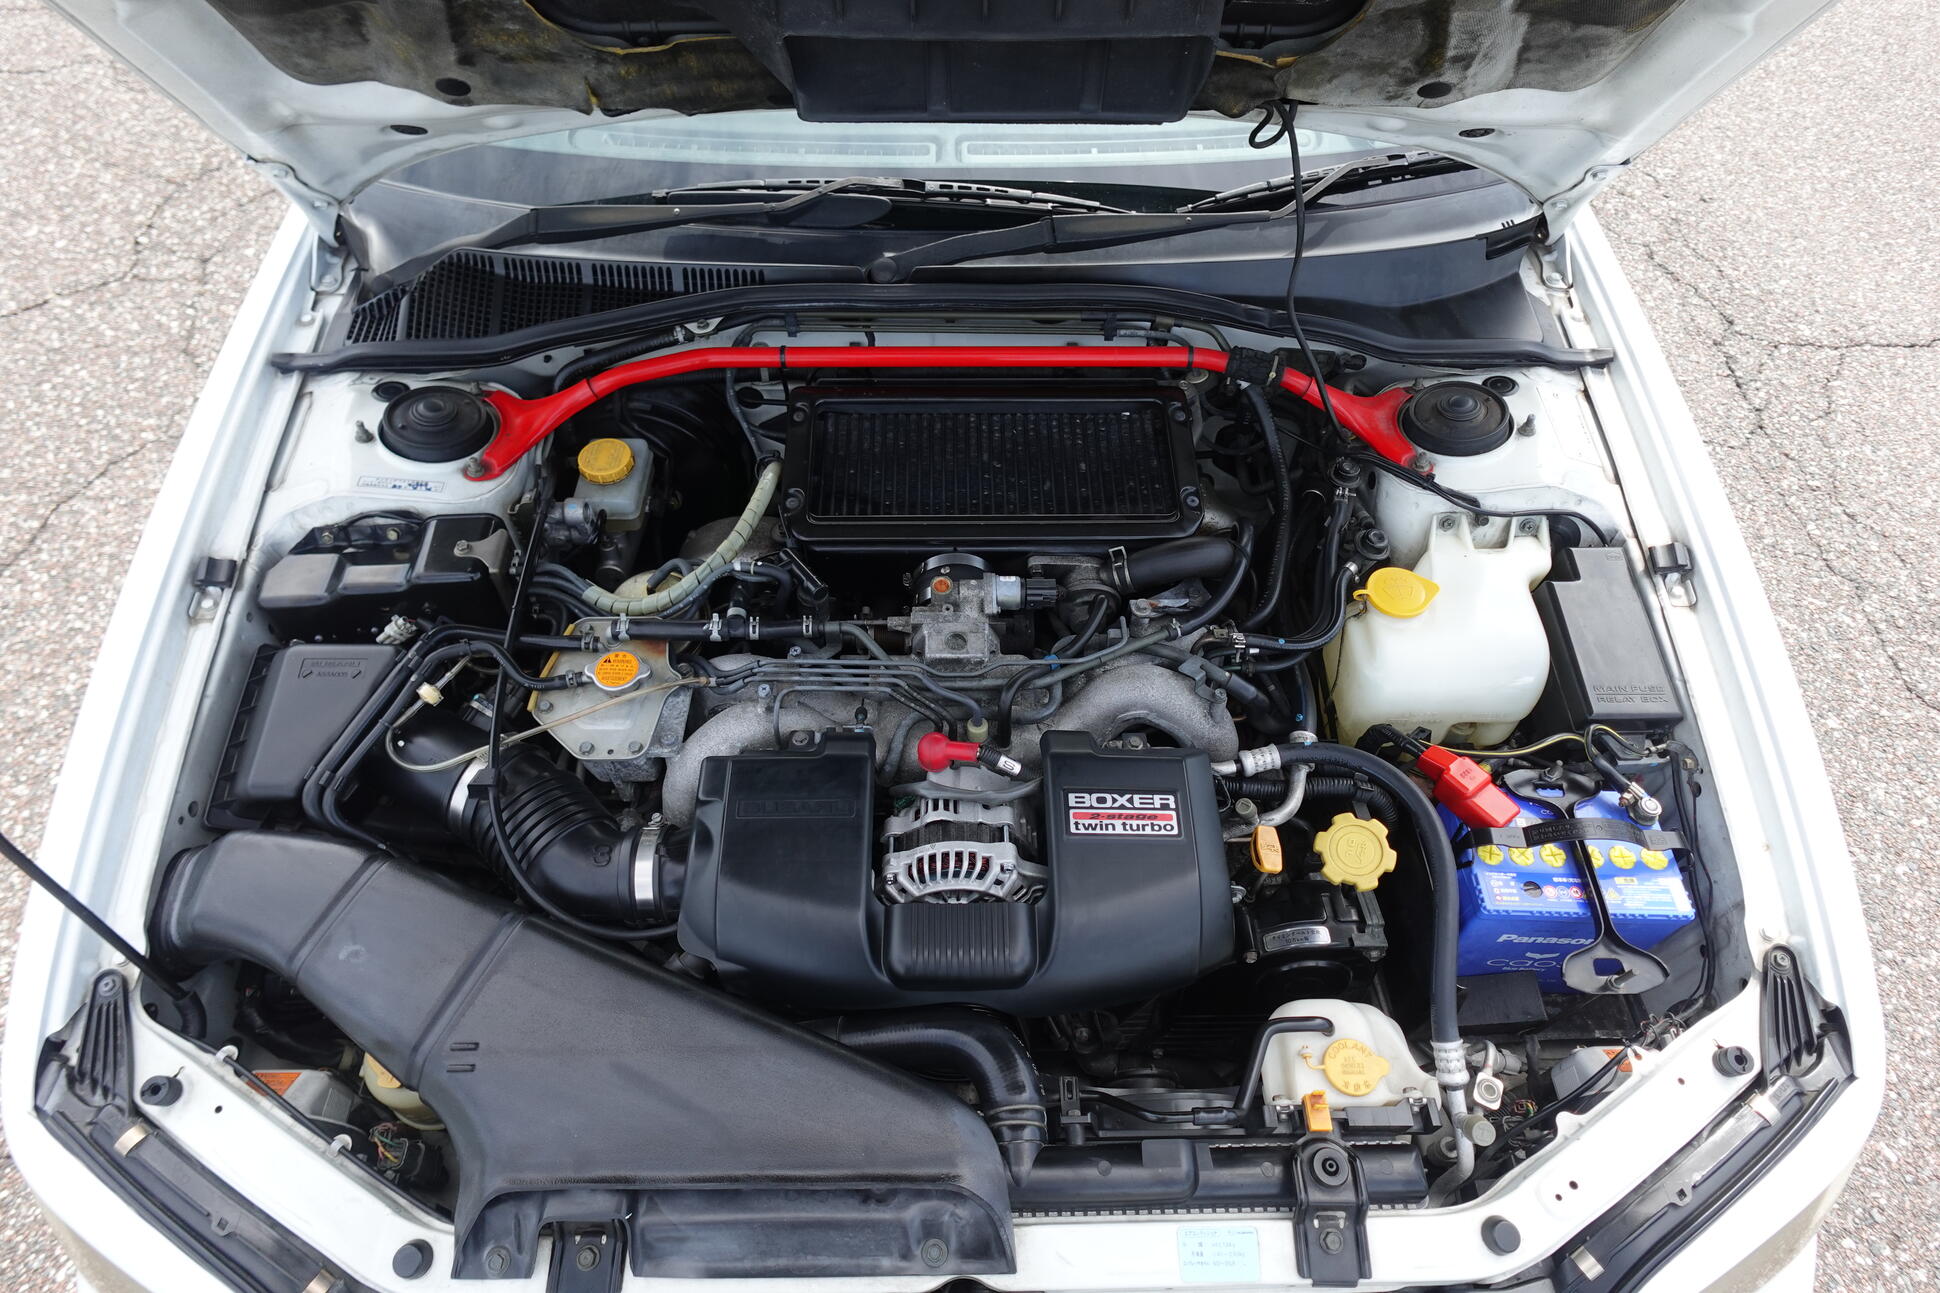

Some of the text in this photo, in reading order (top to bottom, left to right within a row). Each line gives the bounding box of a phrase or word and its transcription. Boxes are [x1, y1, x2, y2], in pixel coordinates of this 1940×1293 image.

[1593, 685, 1664, 693] MAIN FUSE
[1068, 793, 1176, 809] BOXER
[1073, 821, 1175, 832] twin turbo
[1328, 1041, 1374, 1059] COOLANT
